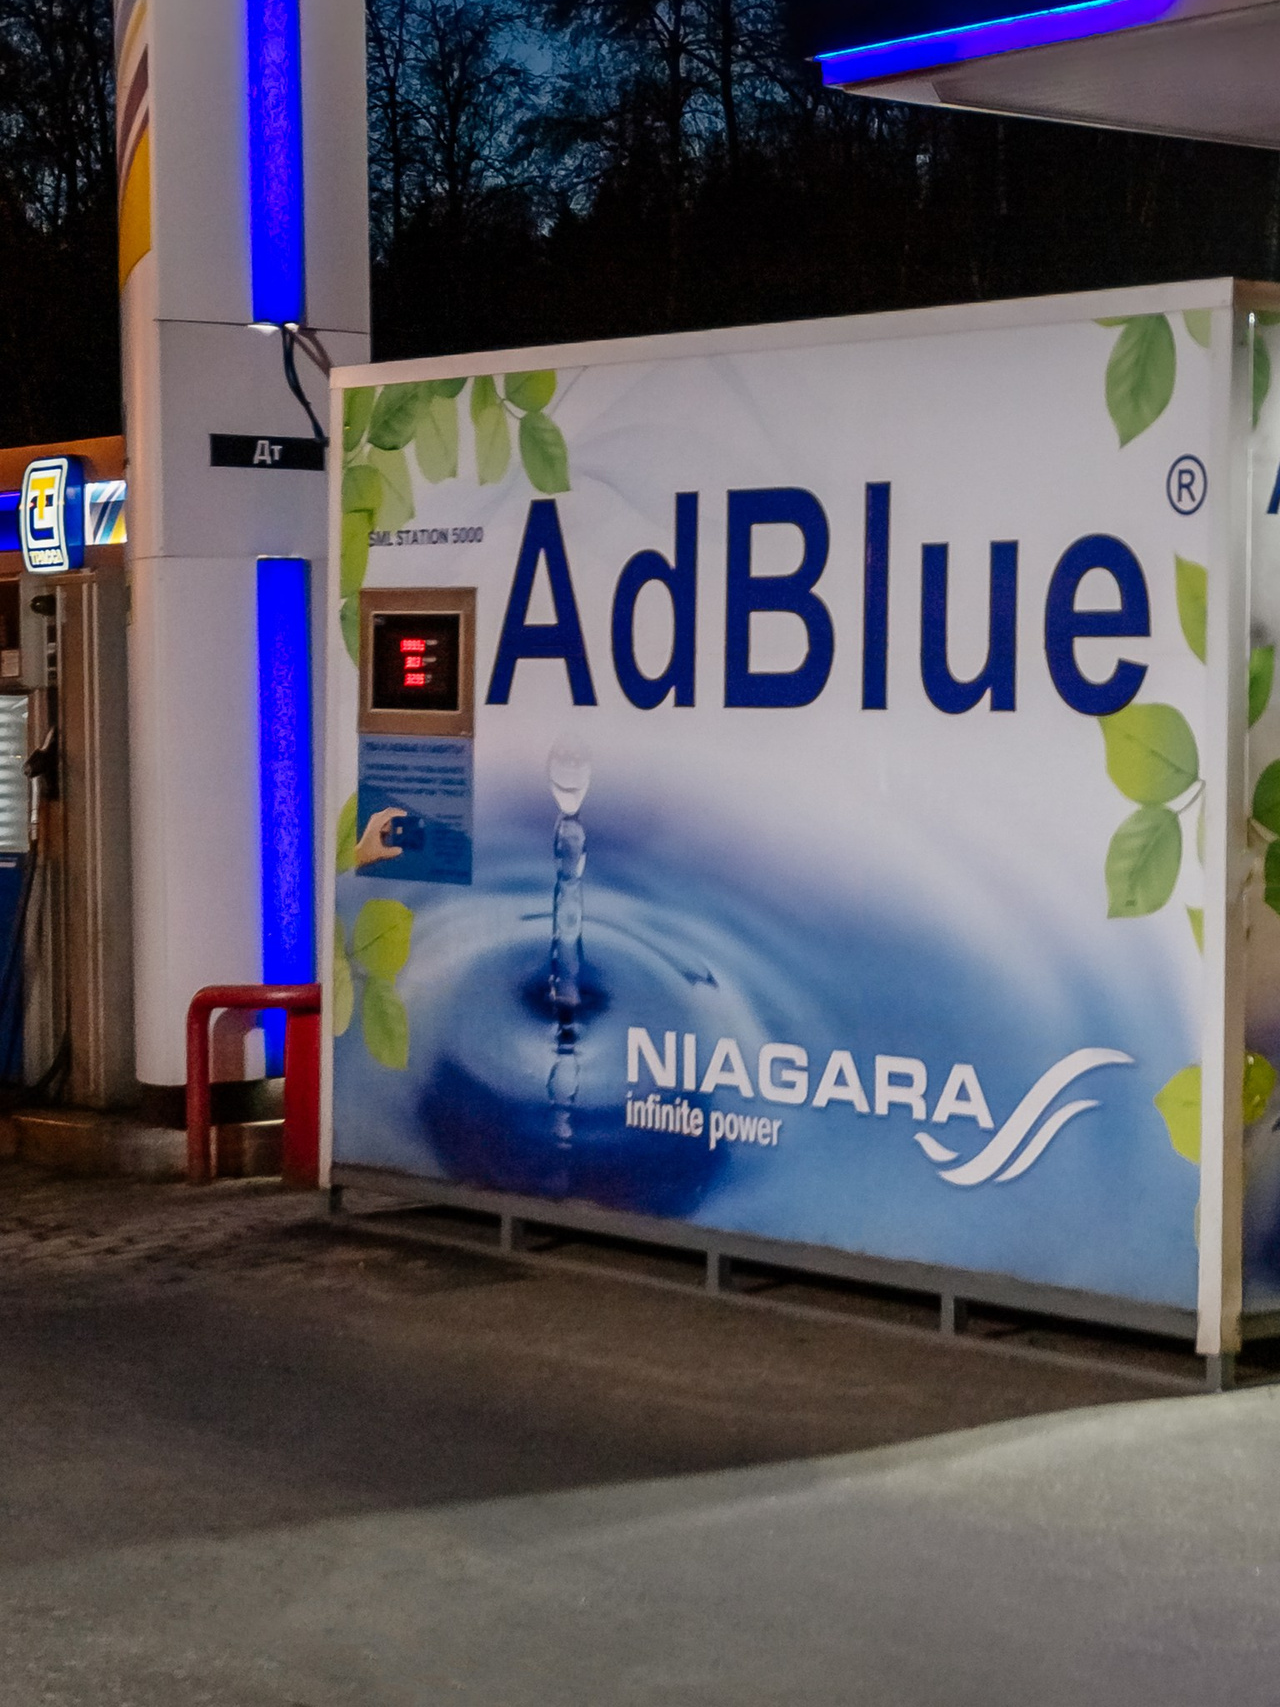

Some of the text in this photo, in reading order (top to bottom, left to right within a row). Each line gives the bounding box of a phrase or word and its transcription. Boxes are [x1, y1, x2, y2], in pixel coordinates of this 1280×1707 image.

[397, 528, 448, 546] STATION
[452, 526, 484, 543] 5000
[485, 481, 1151, 717] AdBlue
[626, 1027, 995, 1131] NIAGARA
[626, 1091, 783, 1150] infinite power
